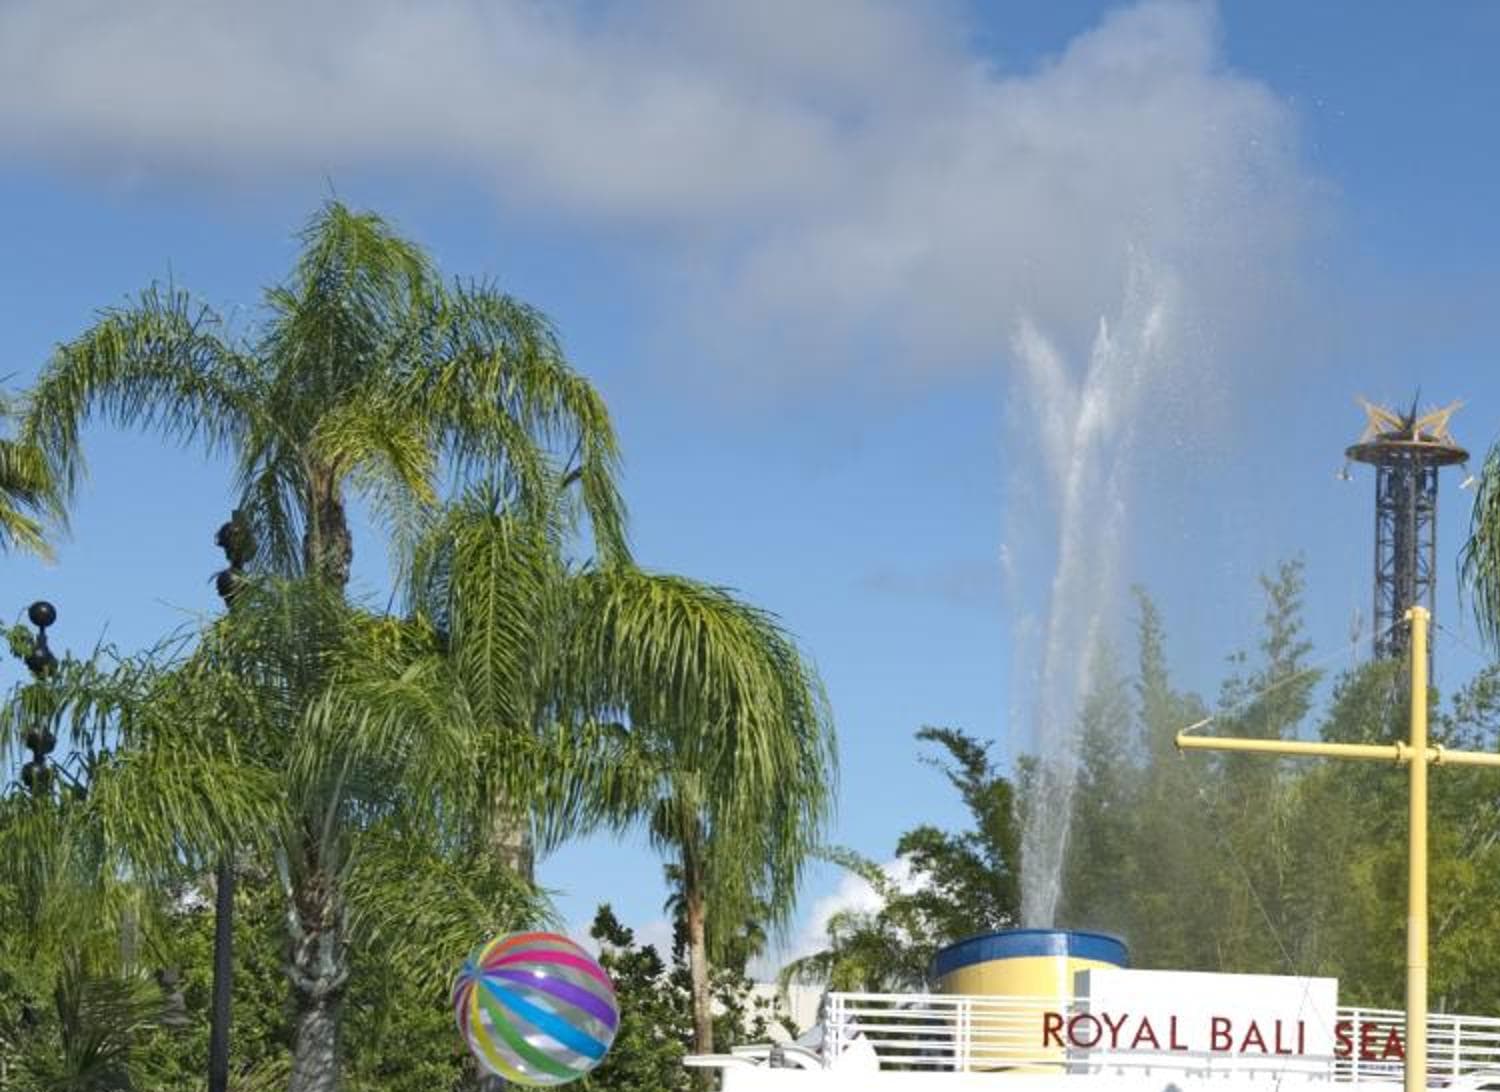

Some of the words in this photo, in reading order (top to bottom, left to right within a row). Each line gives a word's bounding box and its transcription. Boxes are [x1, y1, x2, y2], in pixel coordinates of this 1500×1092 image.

[1043, 1012, 1189, 1051] ROYAL
[1210, 1016, 1307, 1056] BALI
[1333, 1021, 1406, 1061] SEA
